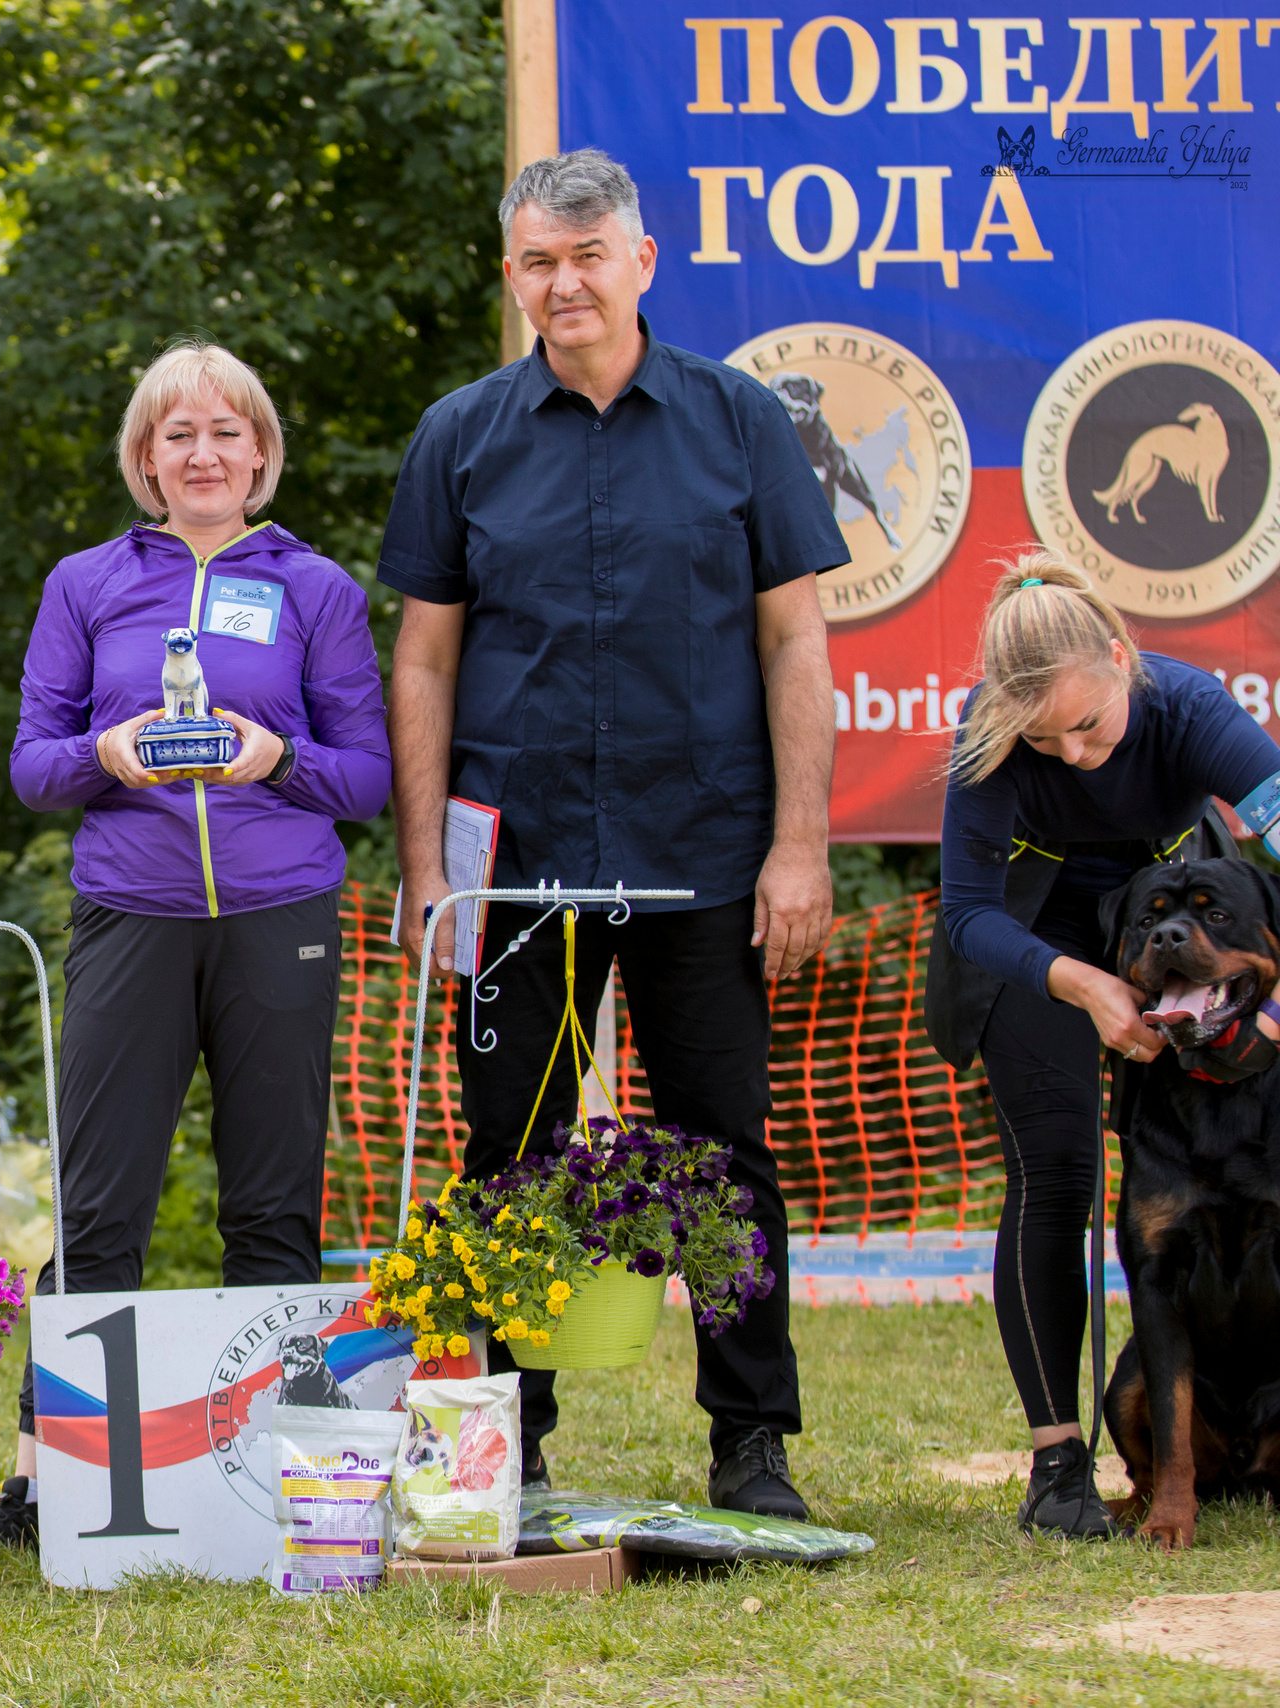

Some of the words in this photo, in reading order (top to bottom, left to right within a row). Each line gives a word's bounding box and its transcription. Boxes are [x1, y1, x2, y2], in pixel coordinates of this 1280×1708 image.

[688, 163, 1054, 289] ГОДА
[736, 340, 793, 373] ЕР
[815, 335, 908, 380] КЛУБ
[915, 386, 962, 536] РОССИИ
[1035, 402, 1115, 583] РОССИЙСКАЯ
[220, 587, 236, 595] Pet
[237, 589, 266, 600] Fabric
[222, 611, 254, 631] 16
[833, 563, 905, 605] НКПР
[1145, 583, 1198, 601] 1991
[65, 1305, 179, 1538] 1
[212, 1304, 299, 1476] РОТВЕЙЛЕР
[318, 1298, 402, 1333] КЛБ
[290, 1470, 334, 1480] COMPLEX
